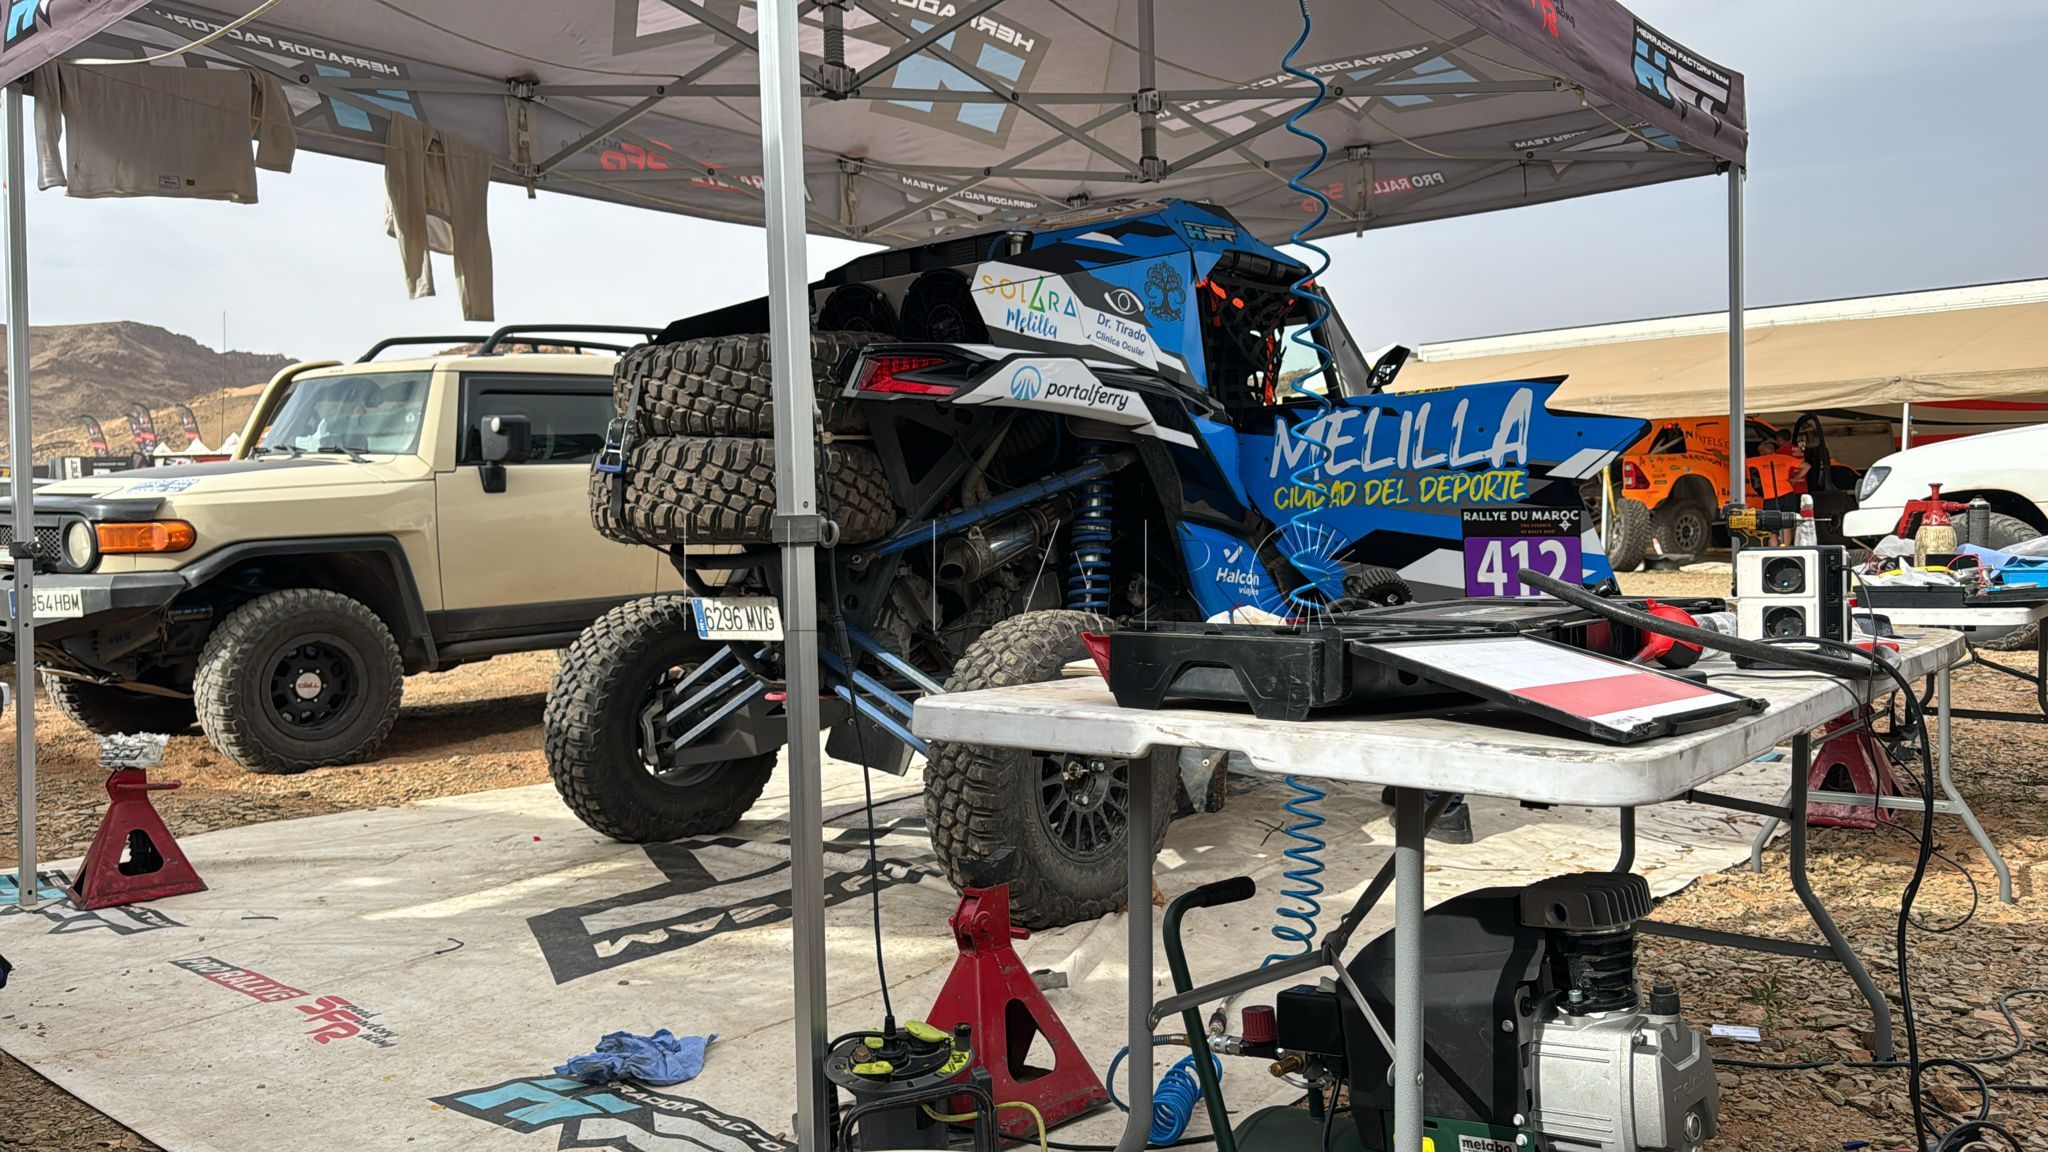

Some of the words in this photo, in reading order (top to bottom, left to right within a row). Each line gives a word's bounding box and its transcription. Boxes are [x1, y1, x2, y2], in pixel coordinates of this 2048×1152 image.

[1636, 25, 1678, 58] HERRADOR
[1678, 51, 1712, 77] FACTORY
[1711, 69, 1730, 87] TEAM
[1005, 307, 1058, 339] Melilla
[1096, 312, 1112, 329] Dr.
[1115, 319, 1148, 344] Tirado
[1121, 340, 1146, 357] Ocular
[1044, 382, 1130, 412] portalferry
[1269, 387, 1534, 481] MELILLA
[1273, 480, 1356, 511] CIUDAD
[1363, 477, 1410, 506] DEL
[1419, 469, 1527, 504] DEPORTE
[1463, 511, 1508, 521] RALLYE
[1511, 511, 1528, 521] DU
[1531, 510, 1580, 521] MAROC
[1476, 539, 1567, 597] 412
[54, 594, 80, 612] HBM
[704, 606, 743, 631] 6296
[745, 606, 775, 631] MVG
[180, 959, 232, 974] PRO
[211, 971, 302, 1002] RALLYE
[1461, 1138, 1513, 1152] metabo
